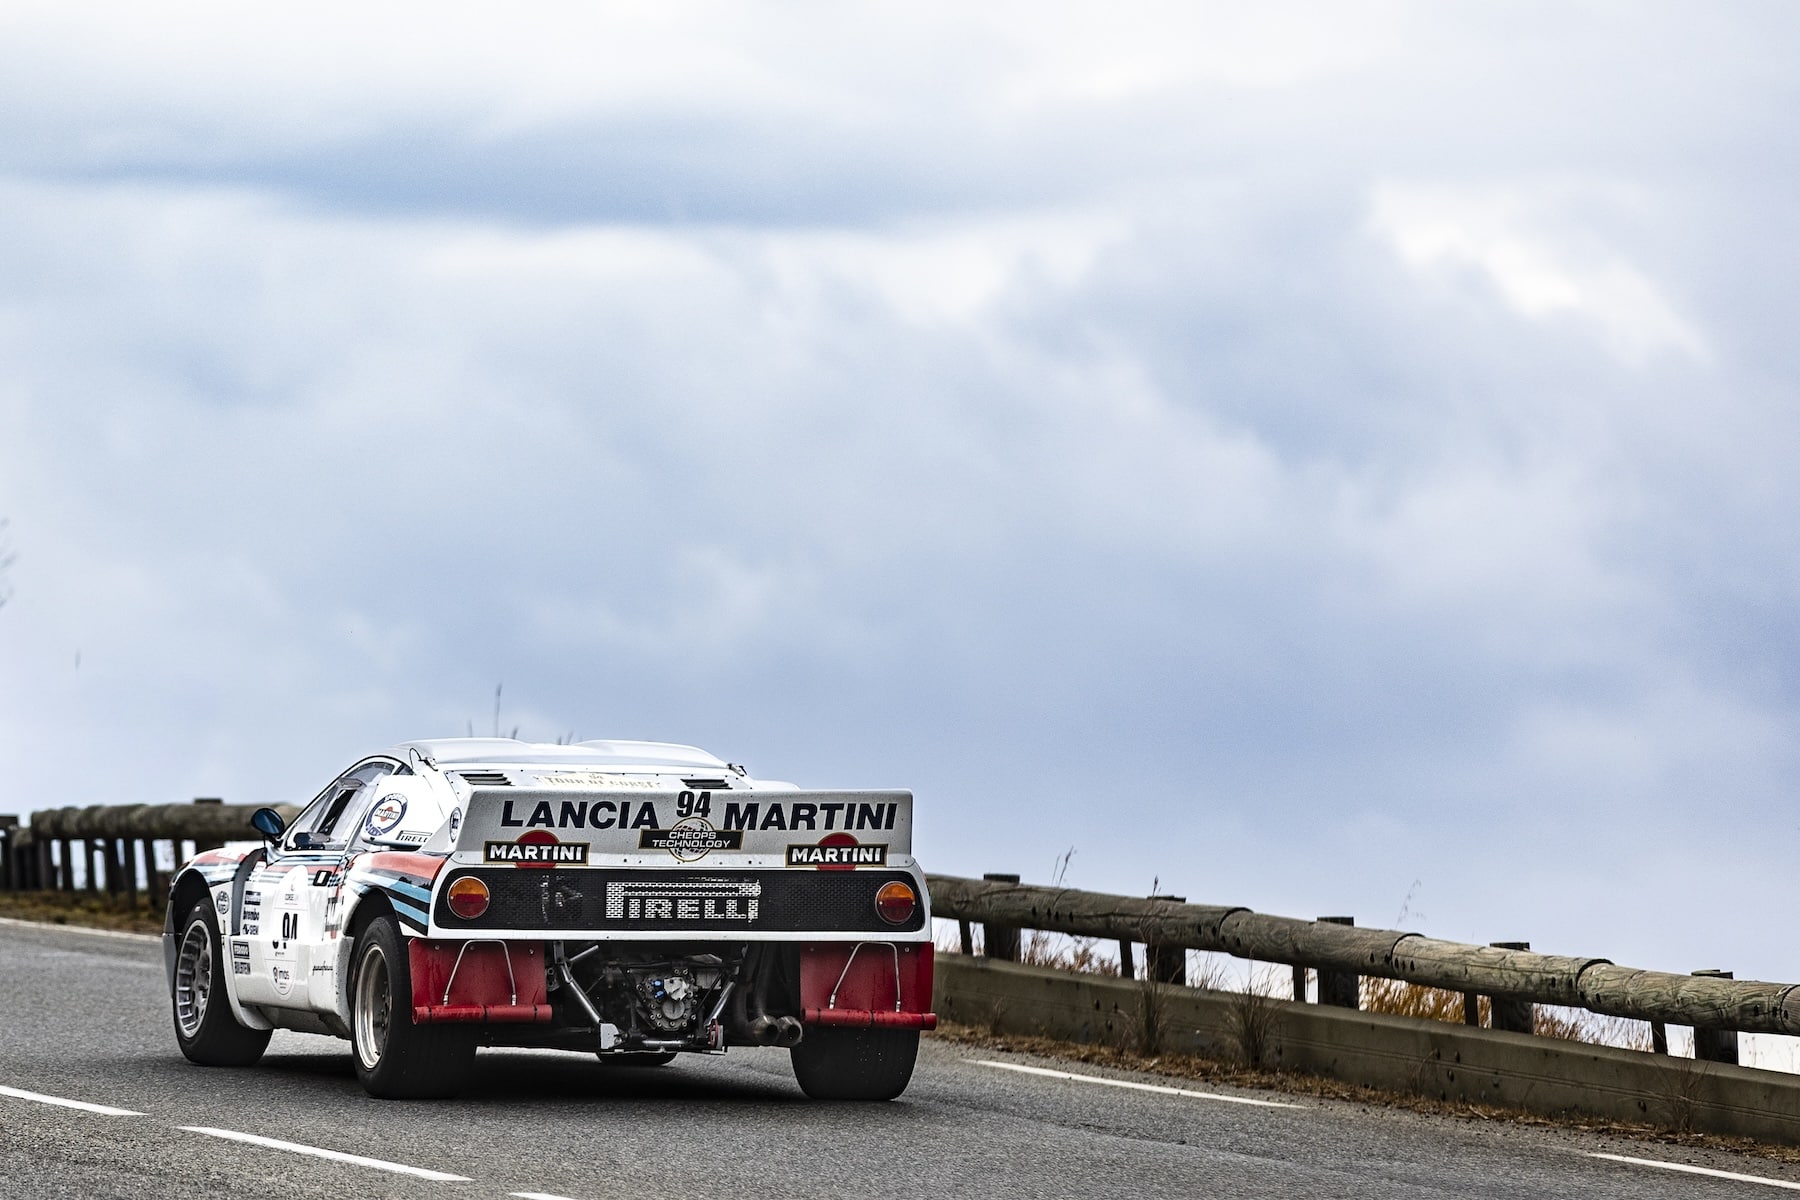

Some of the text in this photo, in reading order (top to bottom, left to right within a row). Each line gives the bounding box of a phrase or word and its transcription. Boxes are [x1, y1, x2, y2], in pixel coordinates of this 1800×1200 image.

[676, 790, 711, 818] 94
[500, 800, 898, 831] LANCIA MARTINI
[652, 839, 731, 848] TECHNOLOGY
[668, 831, 717, 840] CHEOPS
[489, 844, 583, 862] MARTINI
[791, 847, 881, 864] MARTINI
[605, 881, 762, 919] PIRELLI
